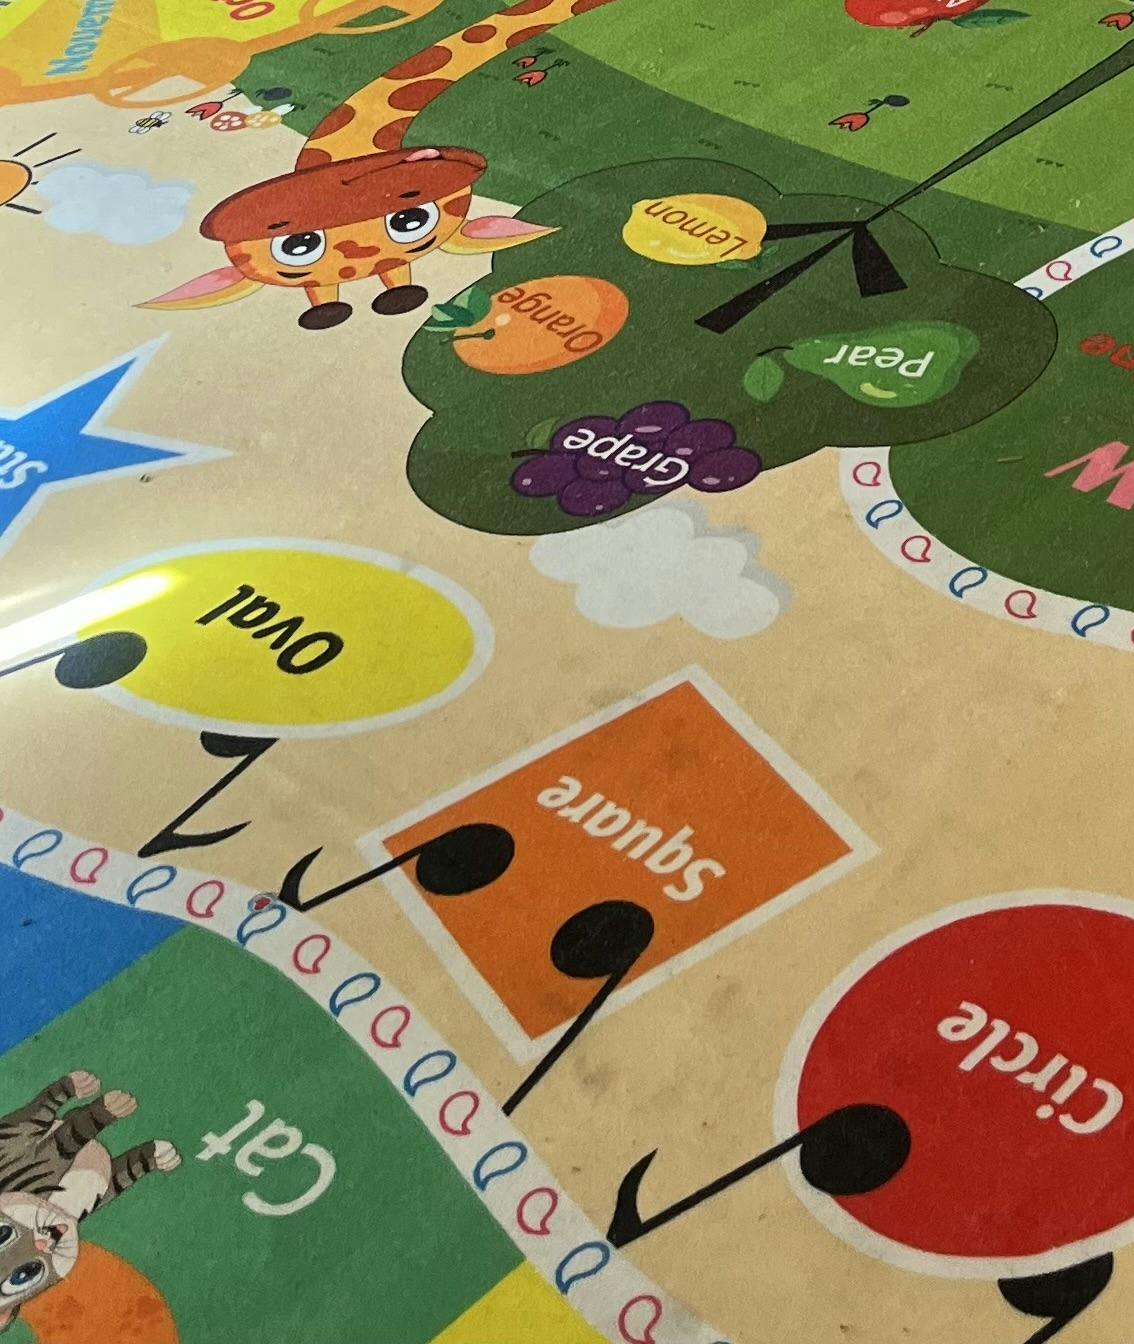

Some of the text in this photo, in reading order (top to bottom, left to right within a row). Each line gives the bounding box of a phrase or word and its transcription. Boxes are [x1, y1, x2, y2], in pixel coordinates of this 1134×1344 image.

[645, 198, 749, 258] Lemon
[498, 285, 606, 356] Orange
[822, 342, 936, 380] Pear
[561, 426, 691, 488] Grape
[194, 583, 346, 676] Oval
[536, 773, 729, 904] Square
[935, 998, 1127, 1136] Circle
[195, 1097, 338, 1218] Cat
